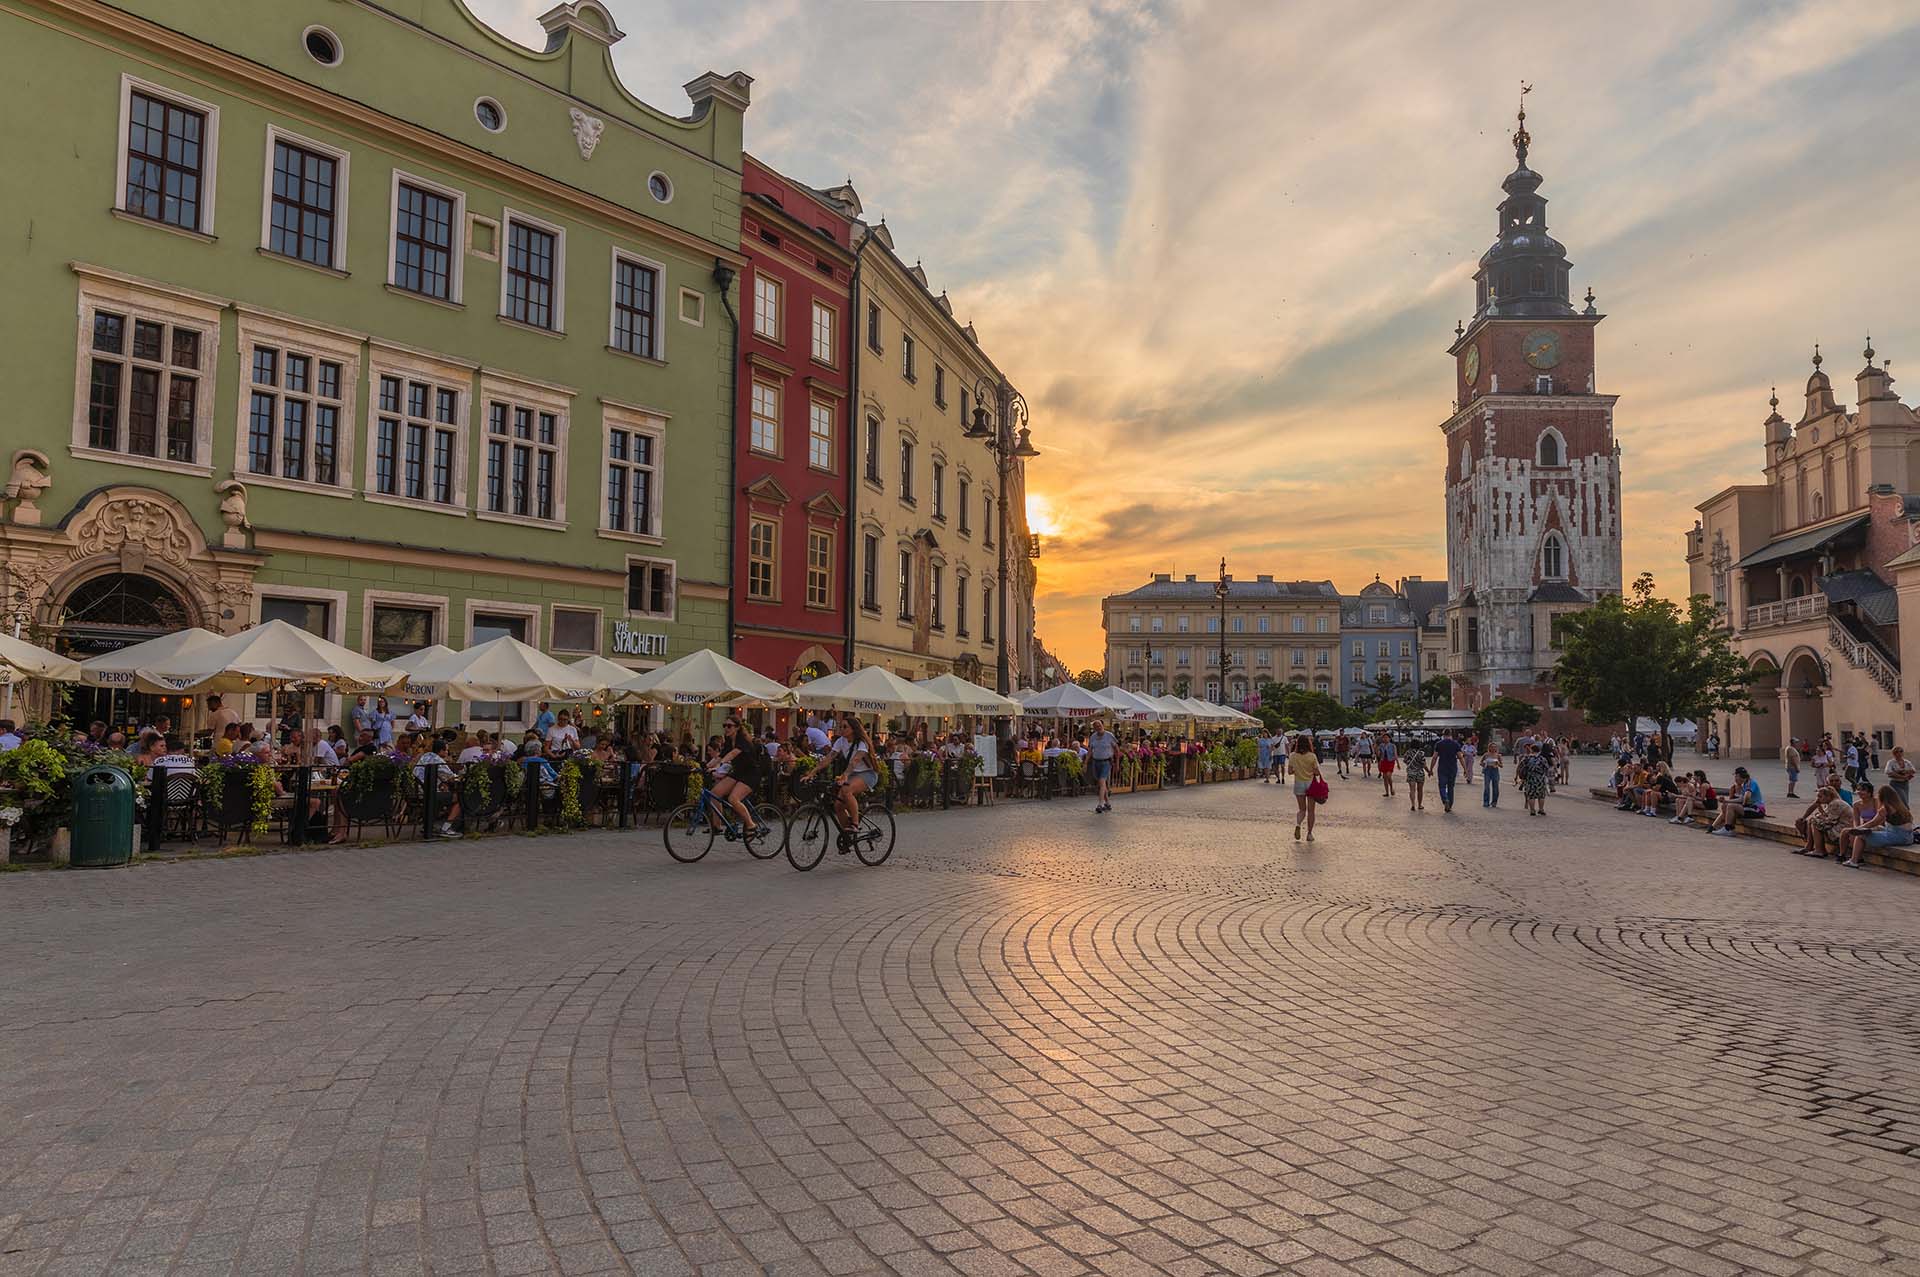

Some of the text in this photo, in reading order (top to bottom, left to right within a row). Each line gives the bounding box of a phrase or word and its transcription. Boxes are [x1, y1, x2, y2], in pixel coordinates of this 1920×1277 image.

[614, 620, 630, 632] THE
[613, 631, 668, 656] SPAGHETTI
[99, 671, 135, 682] PERON
[406, 682, 434, 694] PERONI
[675, 693, 706, 702] PERON
[854, 699, 887, 711] PERONI
[976, 703, 1000, 712] PERONI
